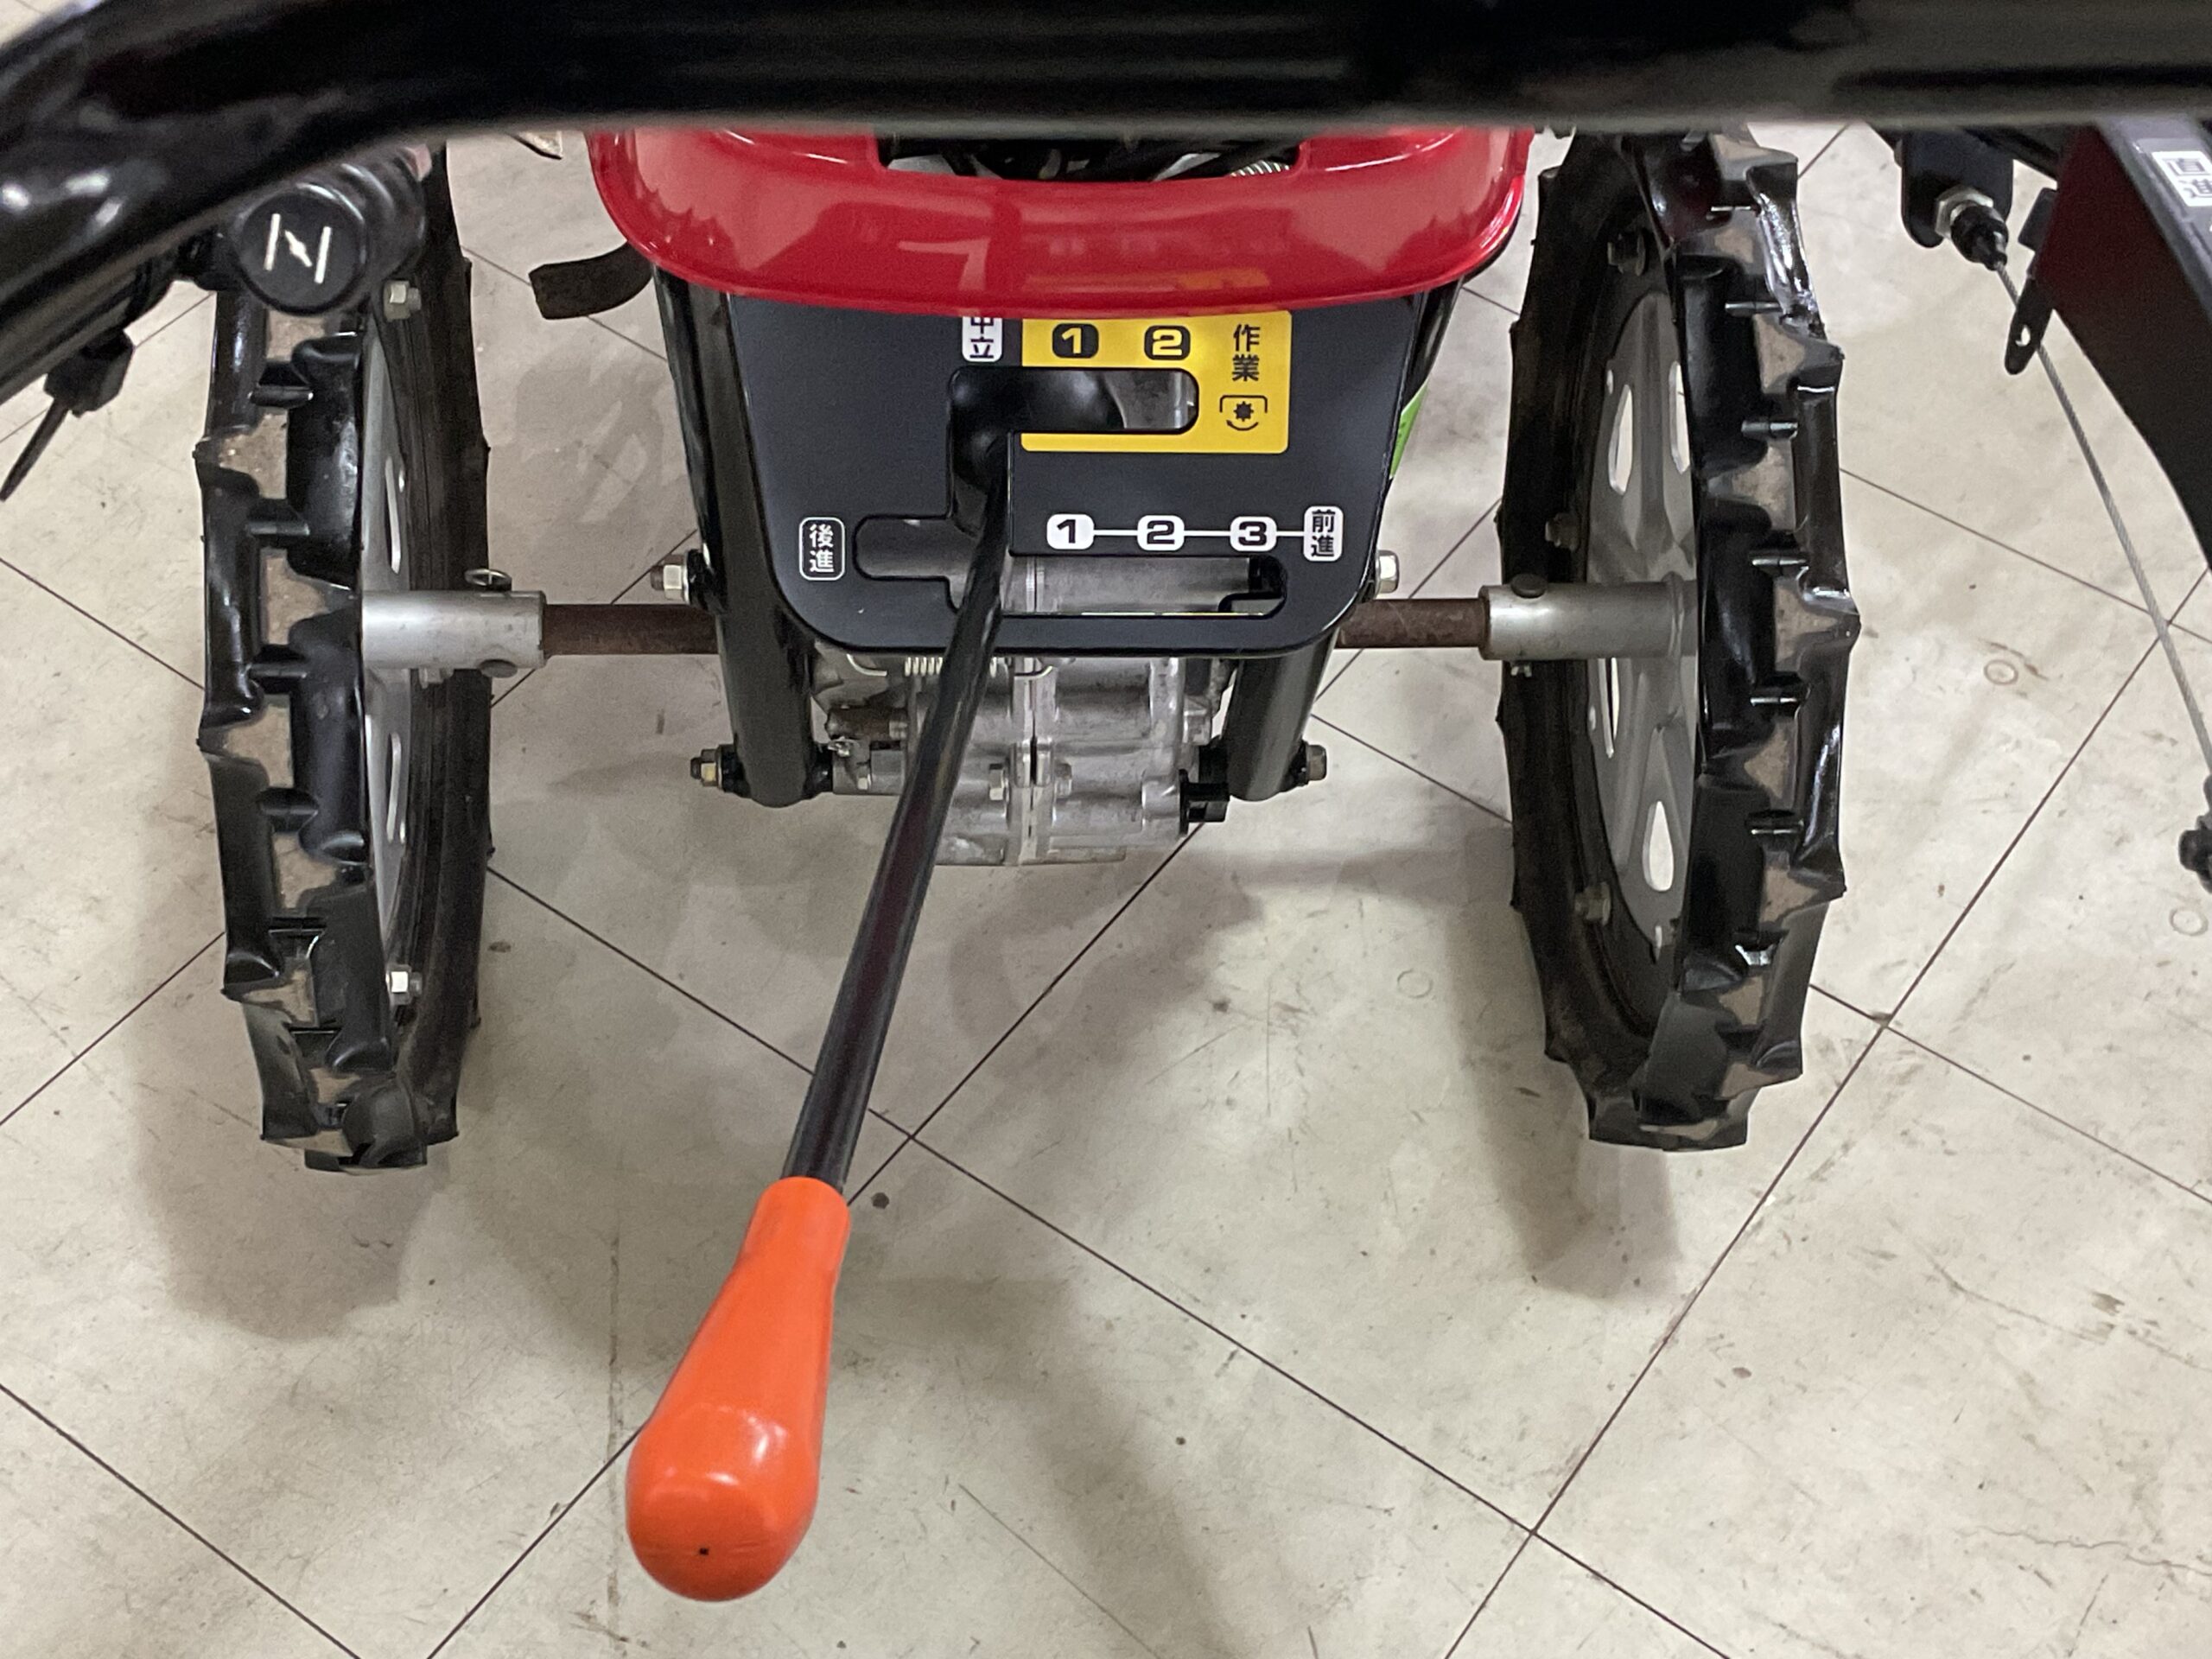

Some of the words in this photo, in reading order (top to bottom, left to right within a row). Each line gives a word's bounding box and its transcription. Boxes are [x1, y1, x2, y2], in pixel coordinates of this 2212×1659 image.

[1062, 327, 1083, 354] 1
[1152, 329, 1184, 356] 2
[1232, 323, 1261, 383] 作業
[810, 523, 835, 573] 後進
[1057, 518, 1077, 544] 1
[1147, 519, 1176, 545] 2
[1238, 520, 1268, 546] 3
[1311, 509, 1336, 557] 前進
